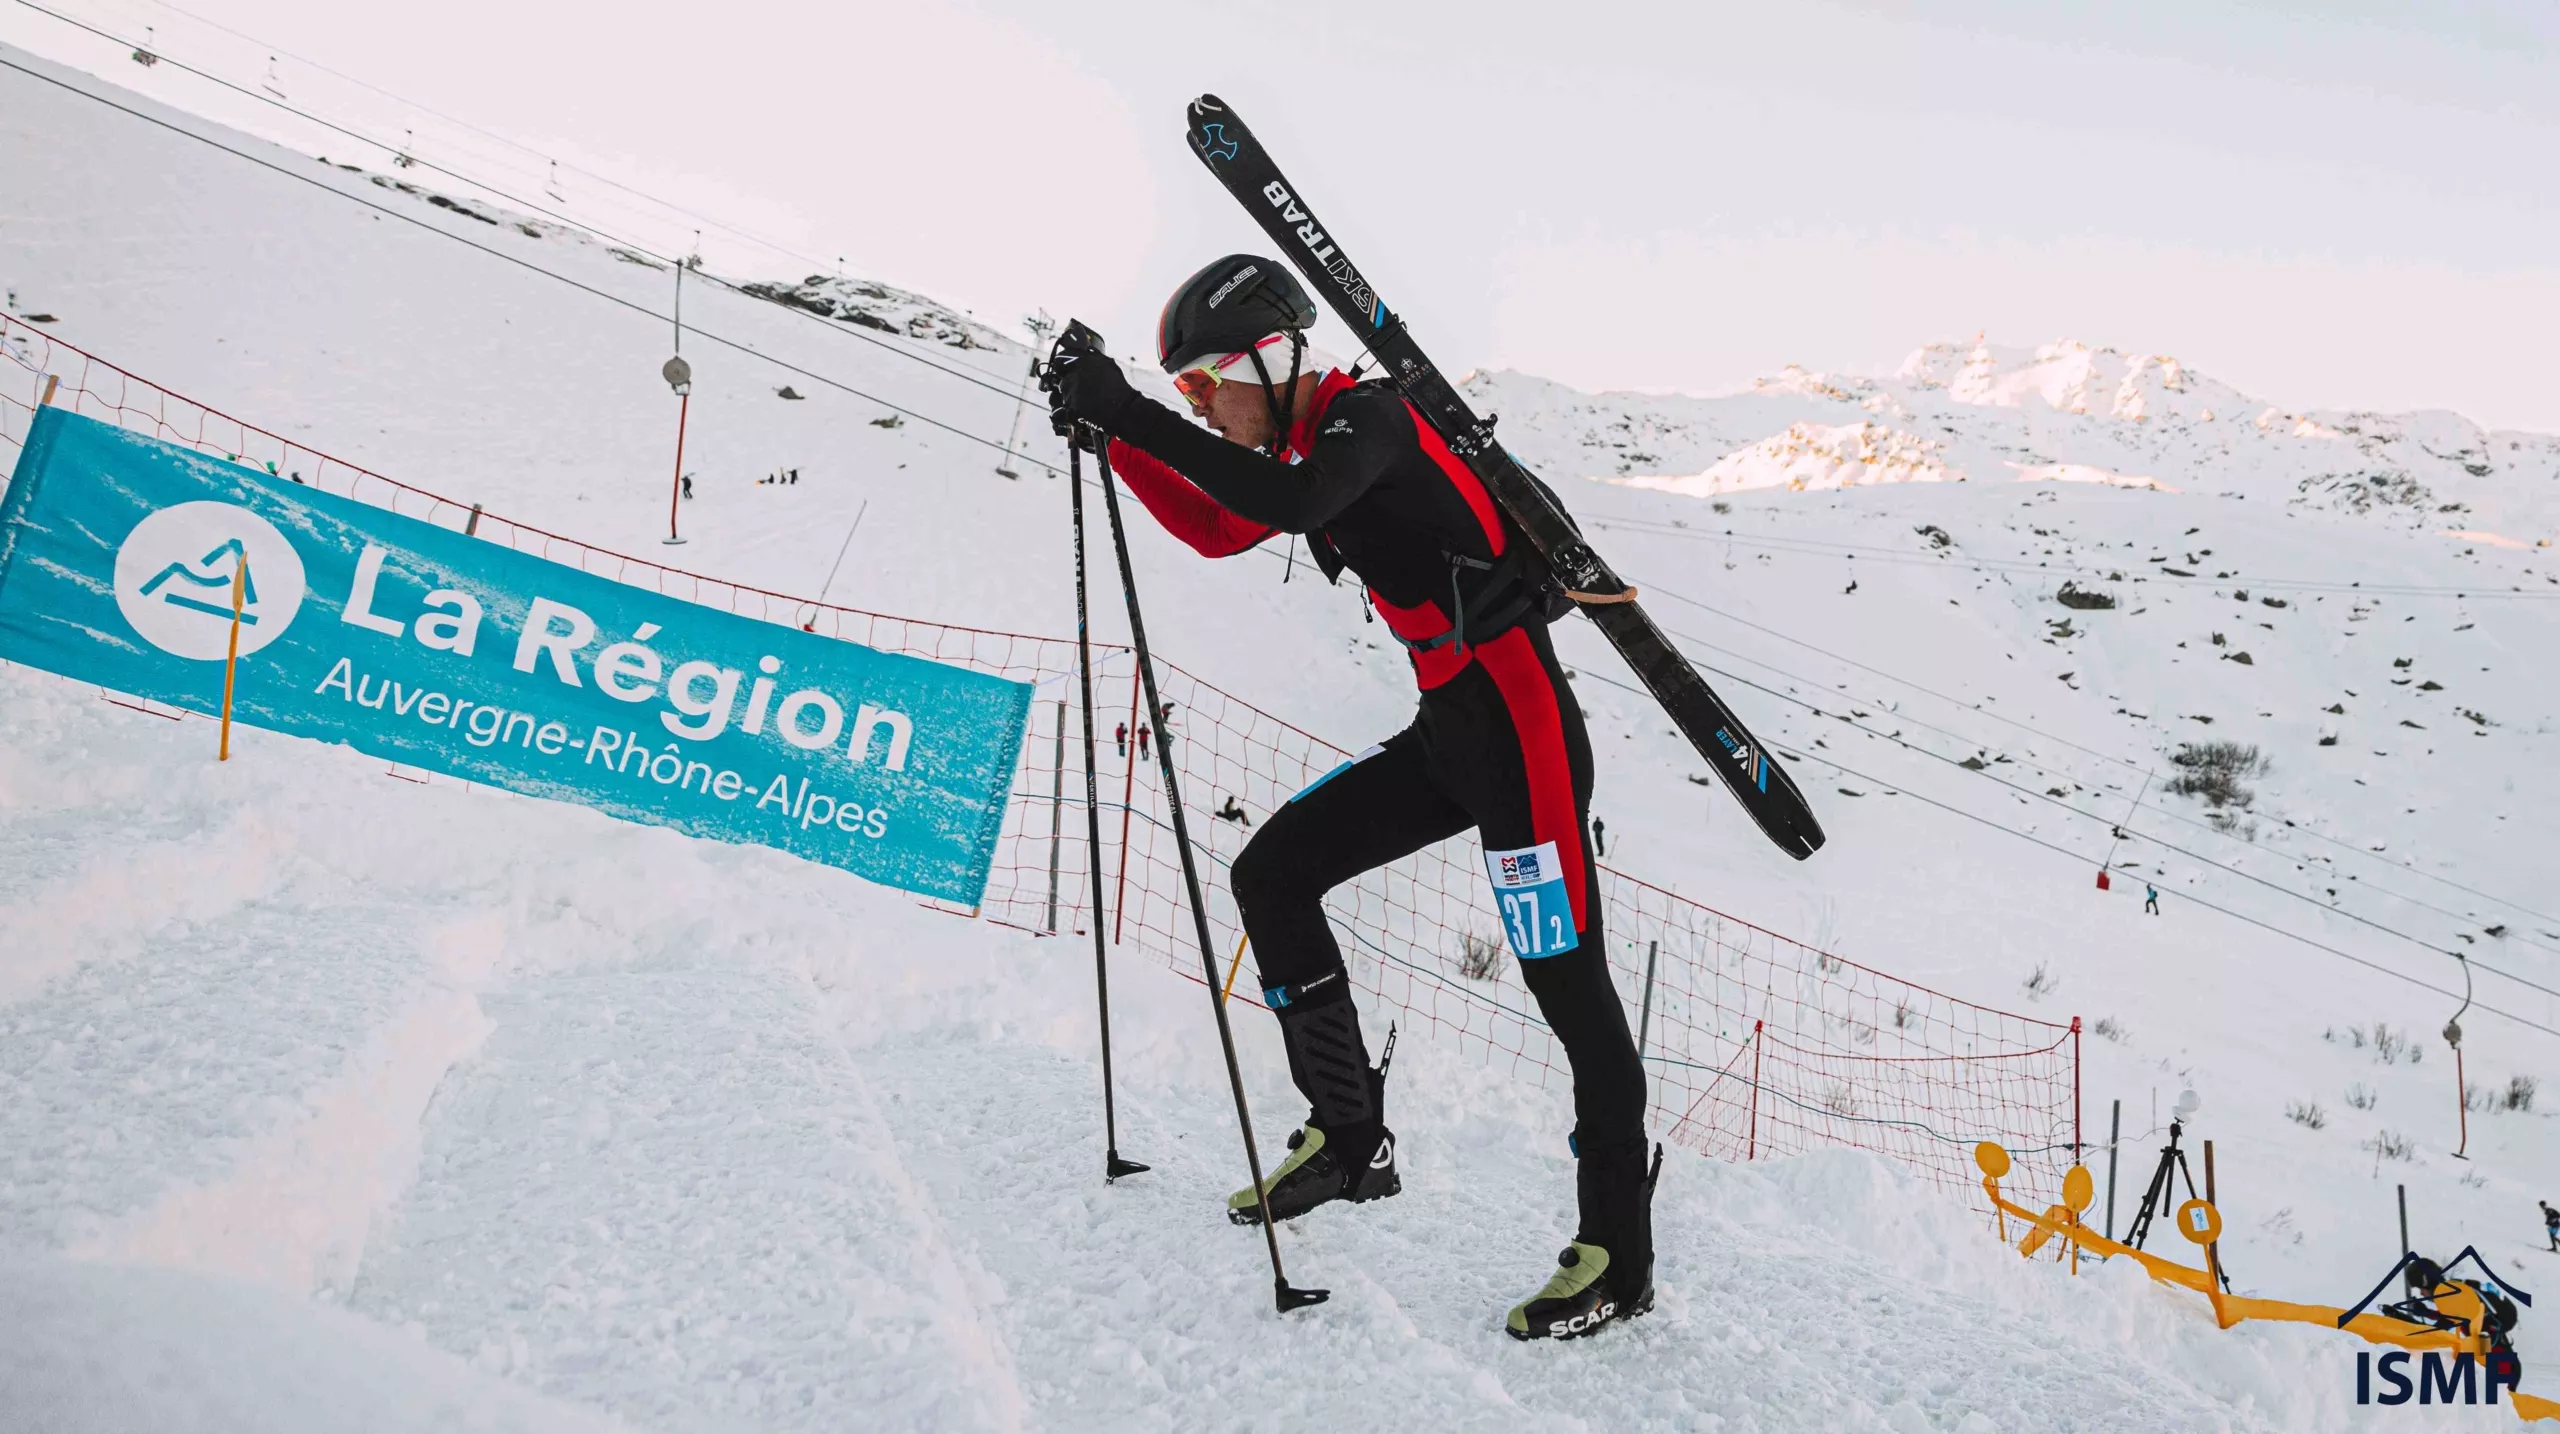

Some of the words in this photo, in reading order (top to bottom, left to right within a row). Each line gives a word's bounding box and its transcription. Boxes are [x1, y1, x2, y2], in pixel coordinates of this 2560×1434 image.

[1263, 180, 1377, 314] SKITRAB
[1209, 265, 1258, 309] SALICE
[340, 542, 484, 657] La
[513, 596, 913, 772] Région
[315, 657, 889, 839] Auvergne-Rhône-Alpes
[1716, 729, 1738, 753] LAYER
[1520, 865, 1538, 874] ISMF
[1503, 891, 1542, 955] 37
[1550, 915, 1567, 950] 2
